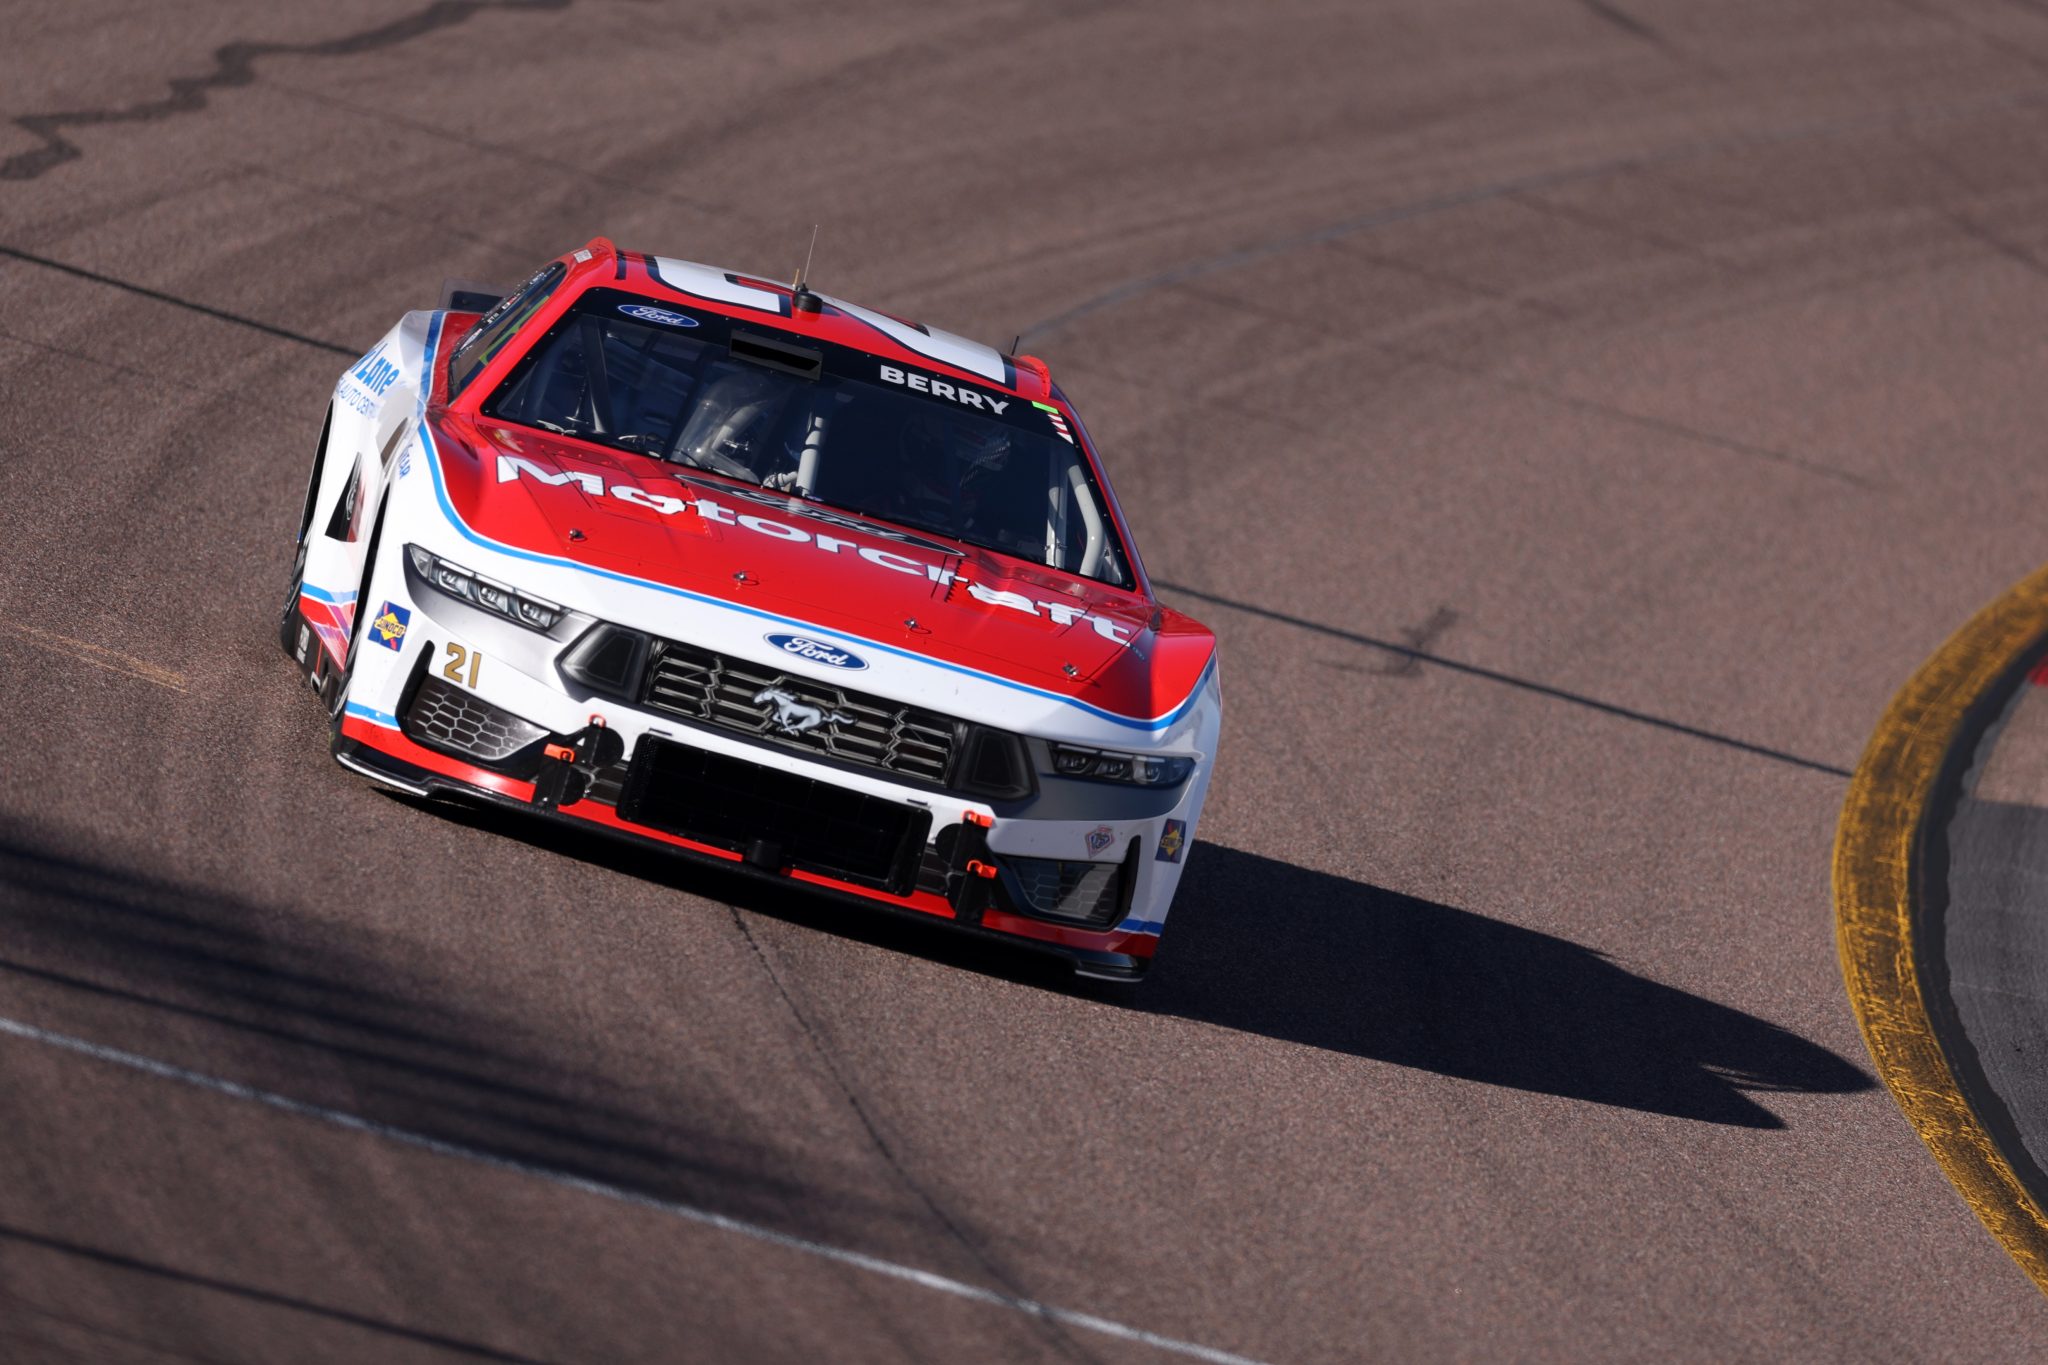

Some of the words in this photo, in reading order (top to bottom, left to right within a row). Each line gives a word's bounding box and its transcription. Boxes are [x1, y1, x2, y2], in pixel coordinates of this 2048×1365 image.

[632, 306, 685, 325] Ford
[355, 343, 400, 397] Lane
[880, 364, 1010, 415] BERRY
[496, 455, 1131, 647] Motorcraft
[443, 641, 482, 690] 21
[783, 637, 849, 665] Ford
